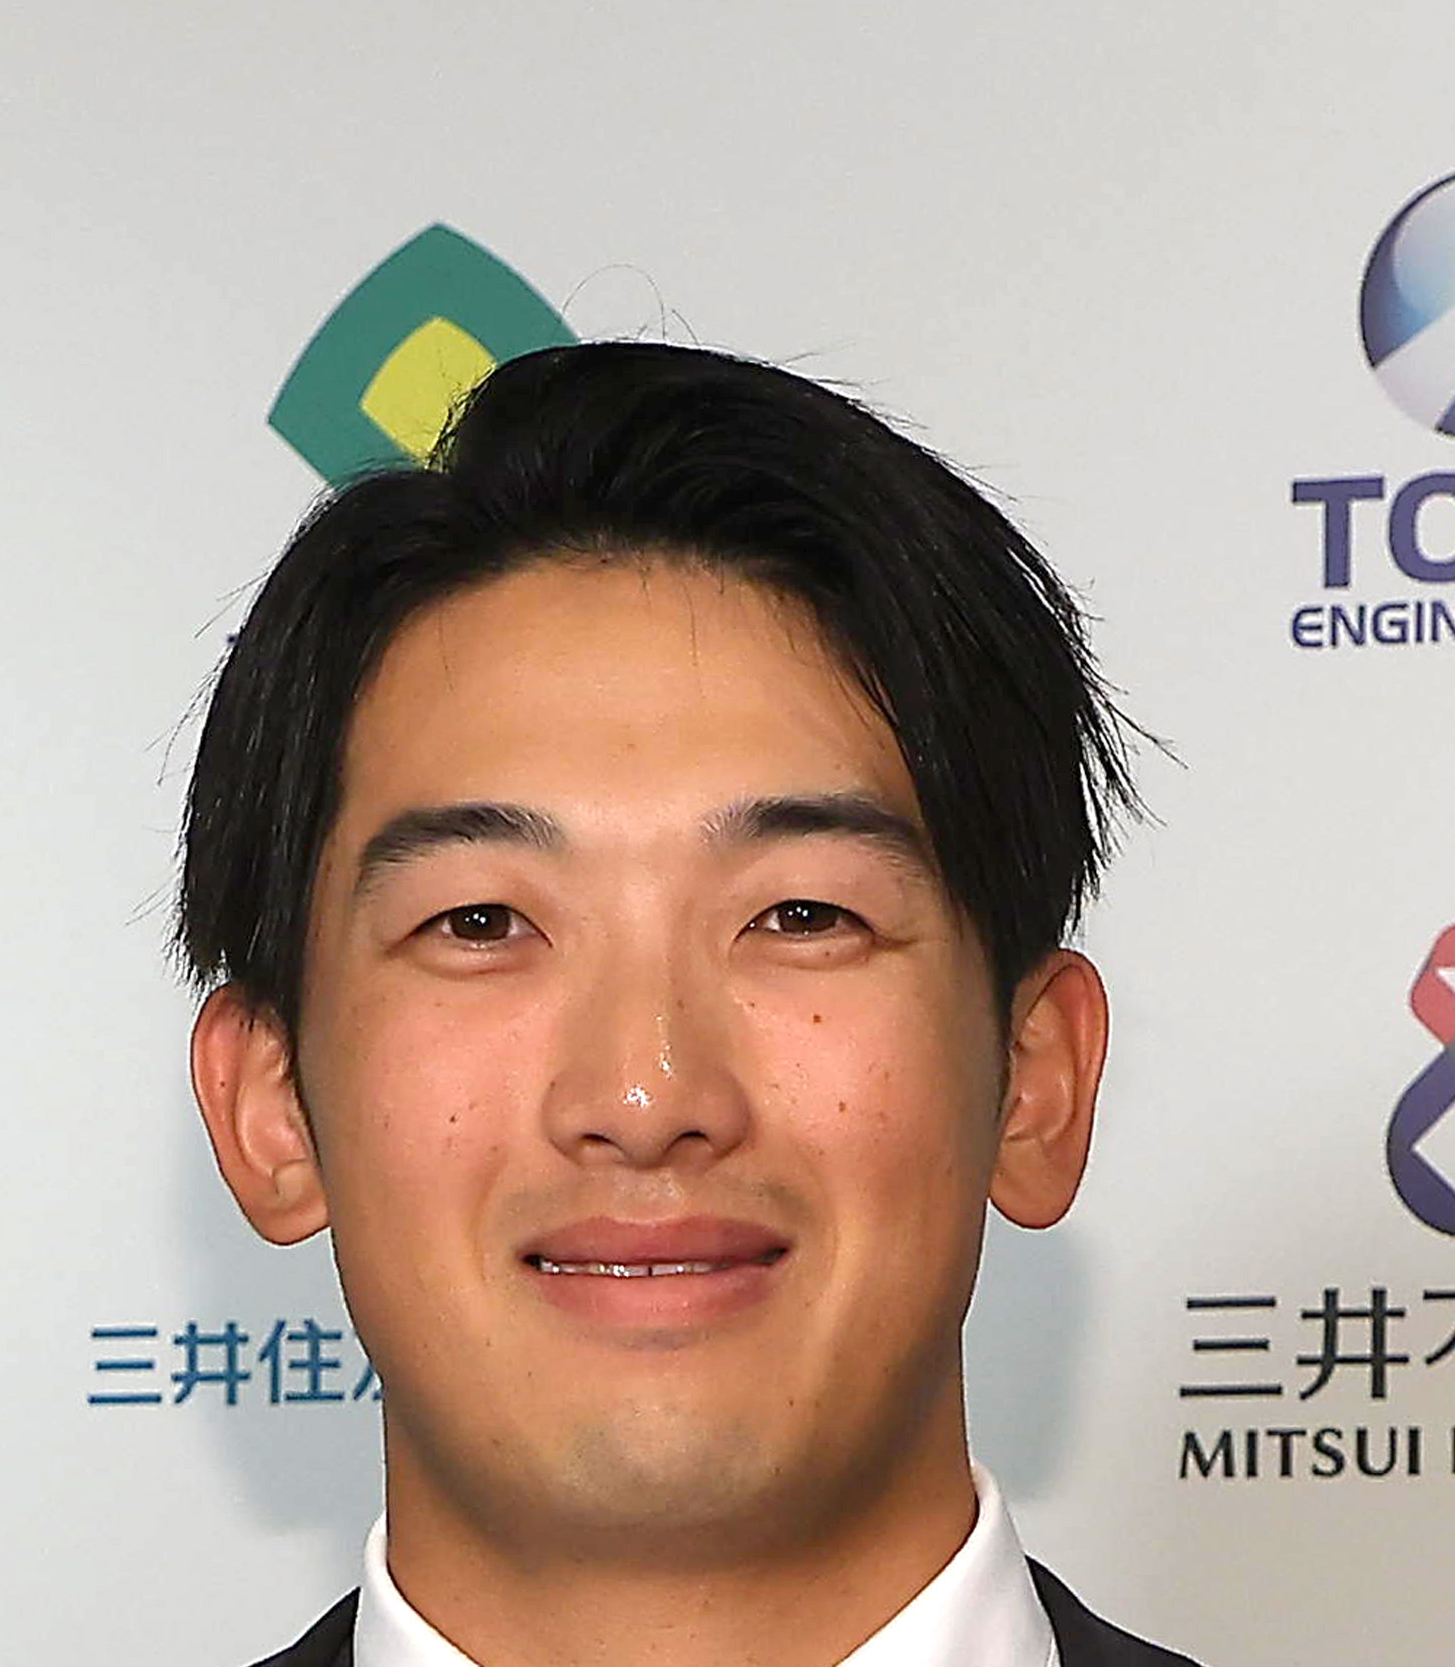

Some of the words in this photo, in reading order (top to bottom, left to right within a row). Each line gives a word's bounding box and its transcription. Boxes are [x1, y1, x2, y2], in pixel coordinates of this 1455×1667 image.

[87, 1317, 384, 1407] 三井住
[1179, 1425, 1420, 1480] MITSUI
